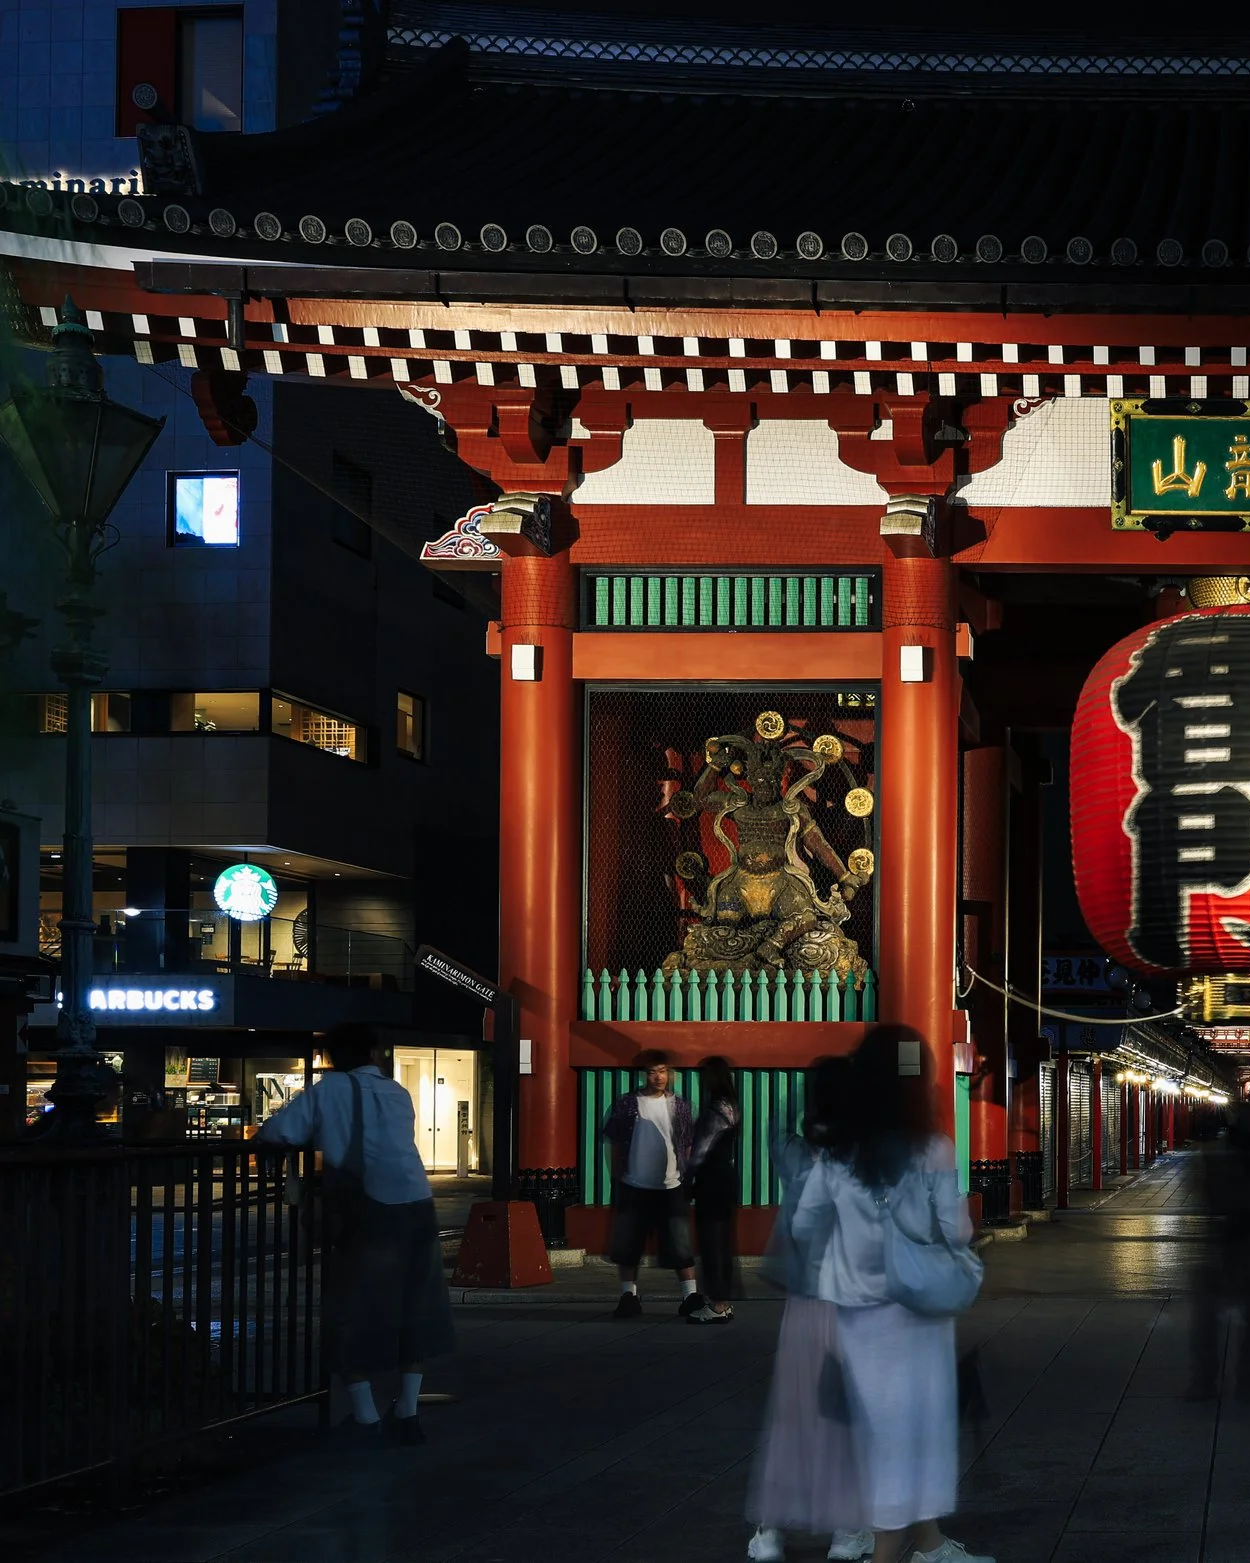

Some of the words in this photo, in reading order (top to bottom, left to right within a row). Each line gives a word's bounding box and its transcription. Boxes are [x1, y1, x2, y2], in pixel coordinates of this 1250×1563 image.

[426, 954, 477, 986] KAMINARIMON
[475, 983, 496, 999] GATE
[57, 989, 215, 1011] ARBUCKS
